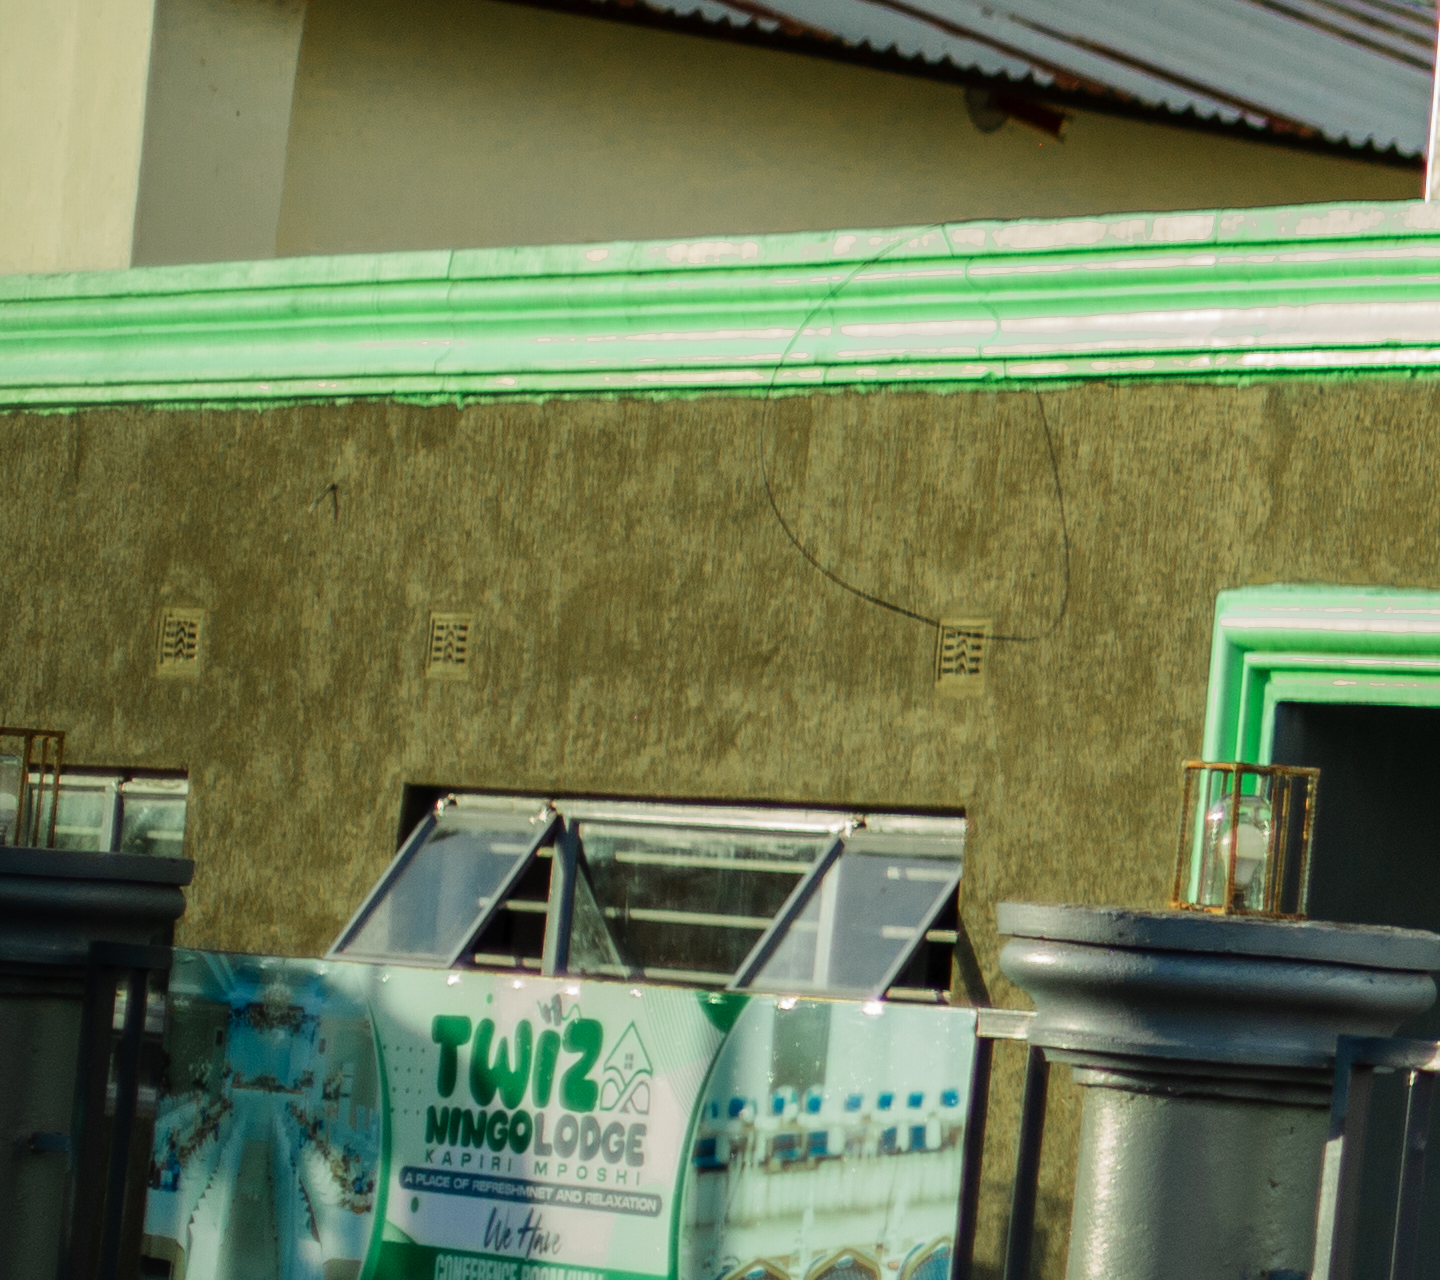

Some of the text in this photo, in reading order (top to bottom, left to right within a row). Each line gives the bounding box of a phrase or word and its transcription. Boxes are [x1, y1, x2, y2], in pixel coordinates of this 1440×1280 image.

[425, 1149, 641, 1187] KAPIRI MPOSHI
[404, 1172, 413, 1185] A
[415, 1173, 451, 1189] PLACE
[453, 1177, 470, 1191] OF
[555, 1188, 582, 1205] AND
[584, 1191, 658, 1213] RELAXATION
[483, 1206, 562, 1260] We Have
